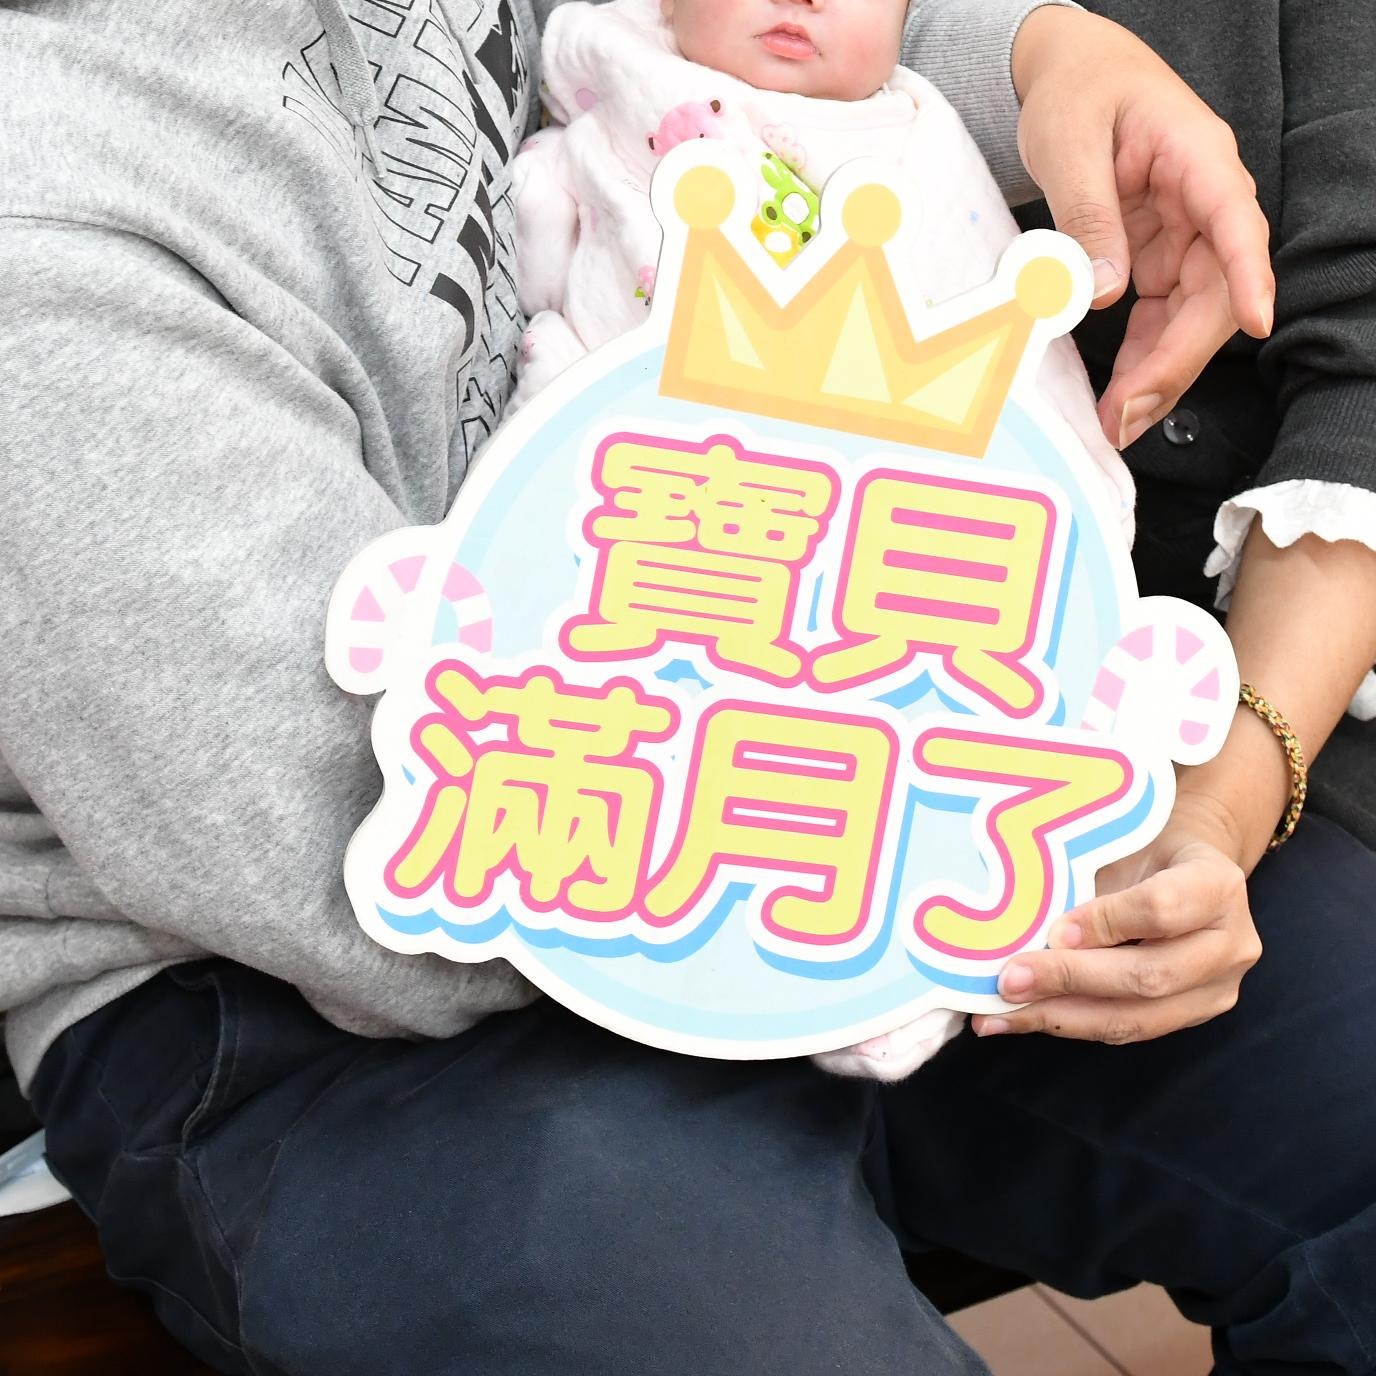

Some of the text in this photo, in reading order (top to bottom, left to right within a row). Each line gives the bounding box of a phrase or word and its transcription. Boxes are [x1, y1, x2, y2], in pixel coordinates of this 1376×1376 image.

[558, 431, 1058, 718] 寶貝
[384, 658, 1134, 960] 滿月了
